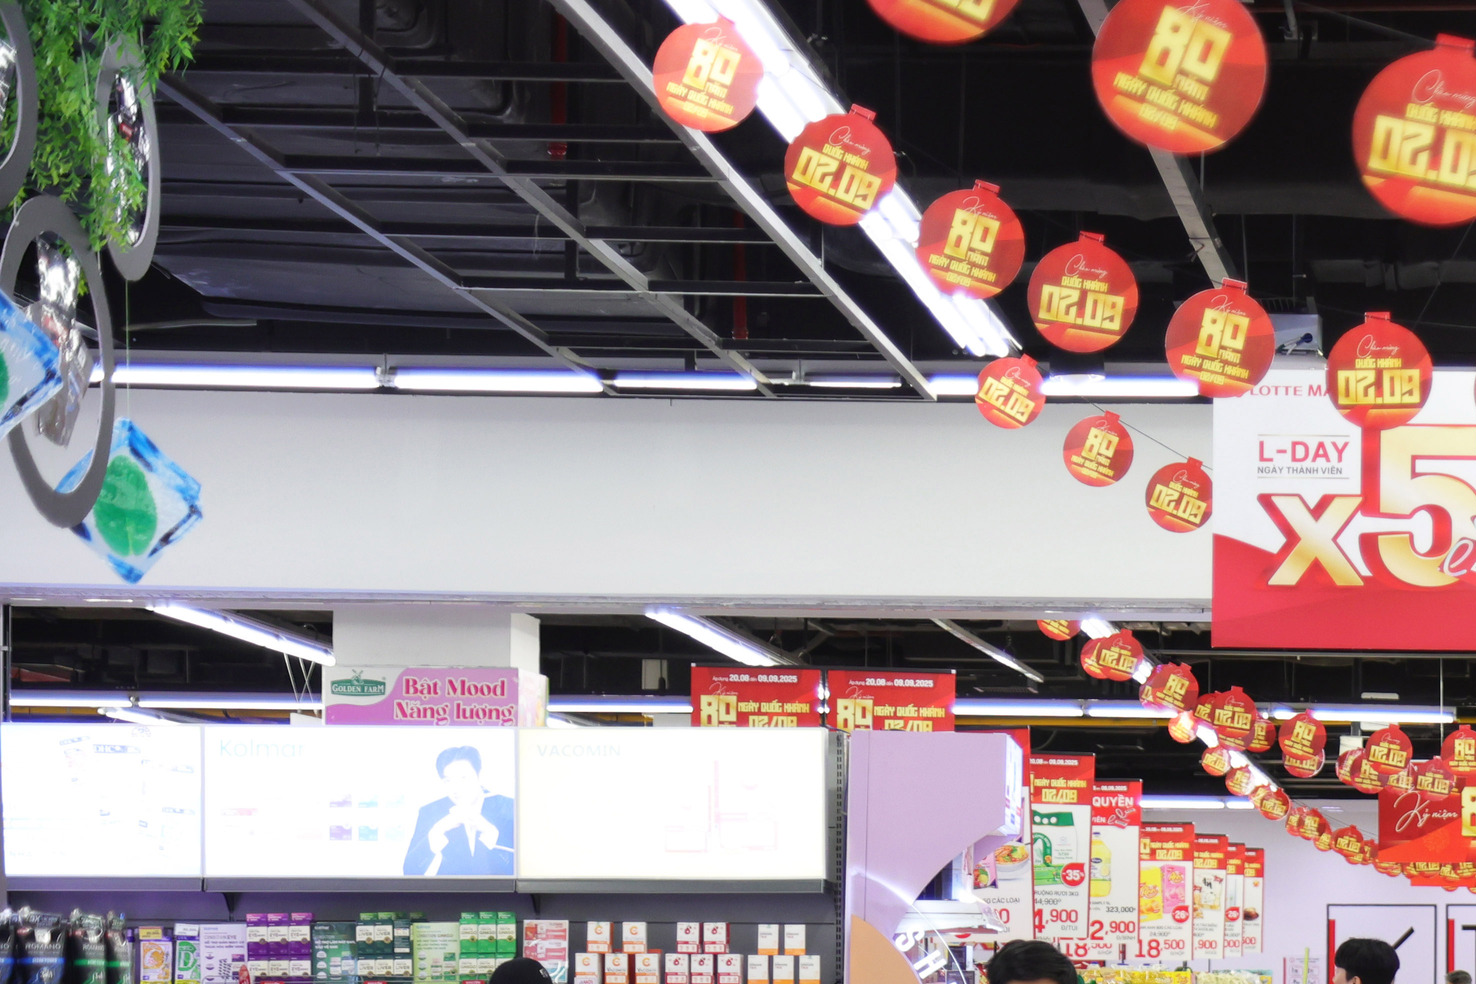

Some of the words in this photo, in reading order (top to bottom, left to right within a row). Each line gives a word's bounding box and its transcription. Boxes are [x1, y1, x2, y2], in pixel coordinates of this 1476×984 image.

[1138, 5, 1232, 87] 80
[683, 38, 741, 90] 80
[792, 146, 882, 210] 02.09
[944, 208, 1001, 260] 80
[1038, 284, 1125, 330] 02.09
[1195, 308, 1250, 358] 80
[979, 376, 1035, 423] 02.09
[1251, 385, 1303, 396] LOTTE
[1337, 368, 1420, 405] 02.09
[1081, 427, 1120, 462] 80
[1258, 440, 1349, 462] L-DAY
[1257, 464, 1284, 474] NGÀY
[1286, 464, 1319, 474] THÀNH
[1321, 463, 1342, 474] VIÊN
[1149, 483, 1207, 524] 02.09
[332, 684, 361, 692] GOLDEN
[404, 678, 439, 699] Bật
[447, 679, 506, 697] Mood
[395, 701, 448, 726] Năng
[456, 703, 514, 726] lượng
[537, 744, 621, 757] VACOMIN
[1092, 794, 1133, 807] QUYỀN
[1135, 940, 1185, 958] 18,500
